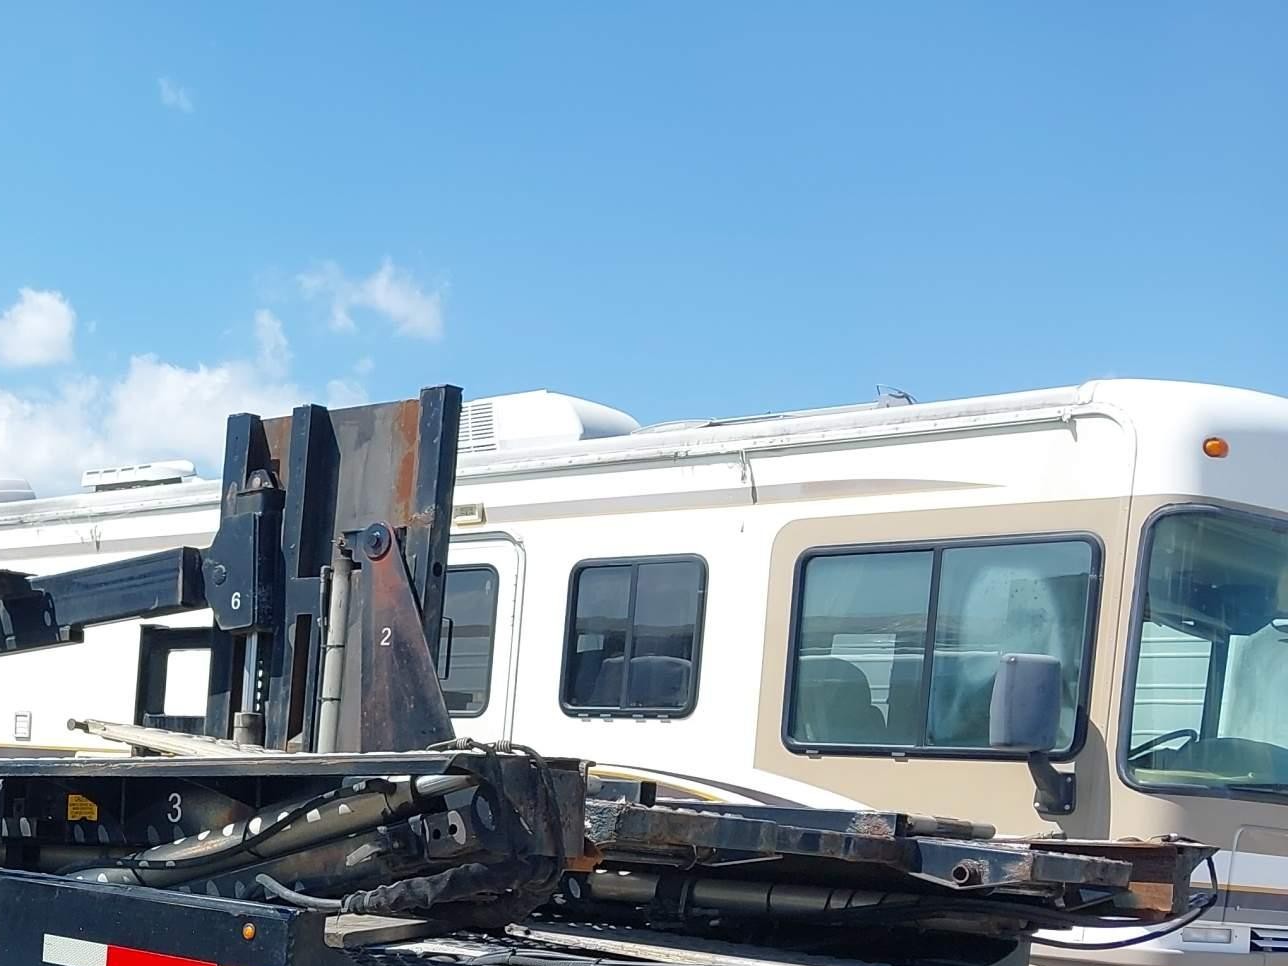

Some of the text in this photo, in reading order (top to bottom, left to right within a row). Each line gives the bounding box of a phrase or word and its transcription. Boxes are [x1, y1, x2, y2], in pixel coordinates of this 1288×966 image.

[231, 592, 241, 610] 6
[380, 627, 392, 646] 2
[167, 792, 182, 823] 3
